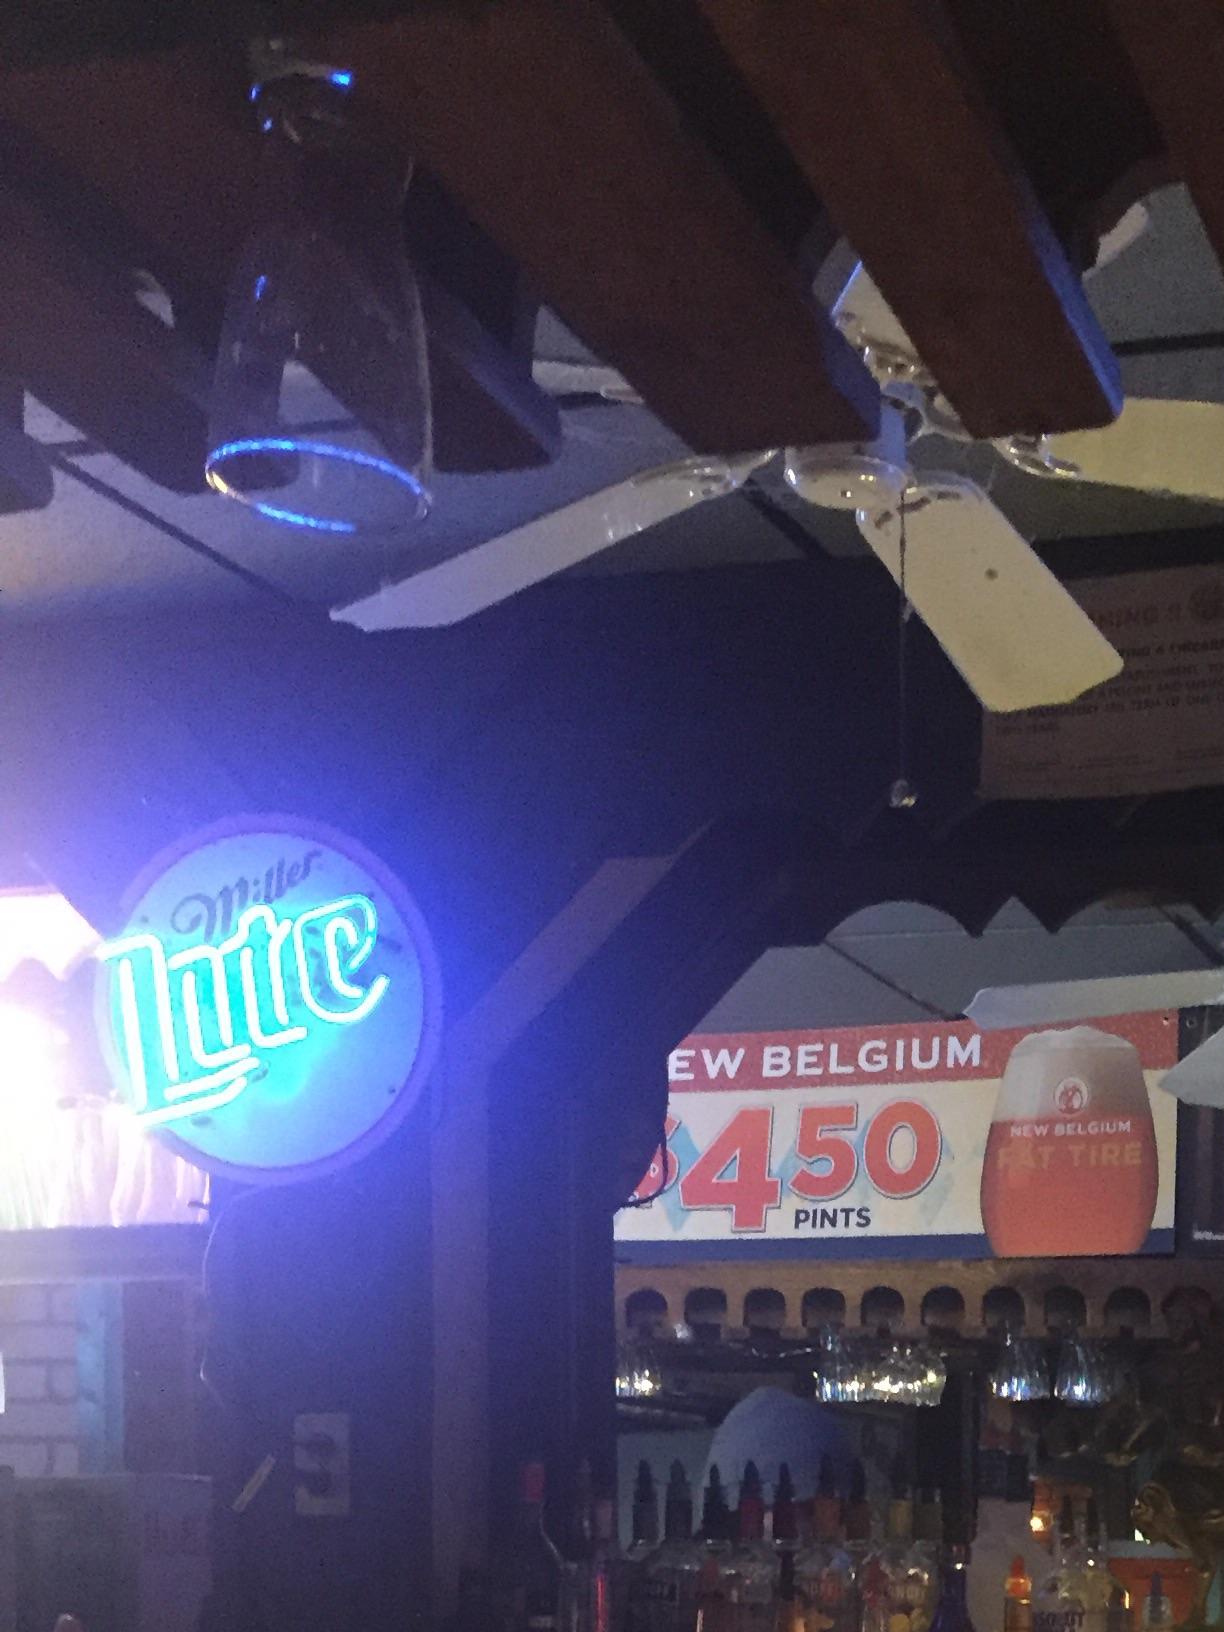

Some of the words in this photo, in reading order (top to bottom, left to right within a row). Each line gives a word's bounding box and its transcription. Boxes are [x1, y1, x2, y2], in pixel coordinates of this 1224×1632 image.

[171, 850, 322, 941] Miller
[95, 893, 390, 1127] Lite
[668, 1047, 745, 1081] EW
[762, 1034, 983, 1078] BELGIUM
[1010, 1123, 1049, 1138] NEW
[1054, 1120, 1131, 1137] BELGIUM
[794, 1206, 871, 1231] PINTS
